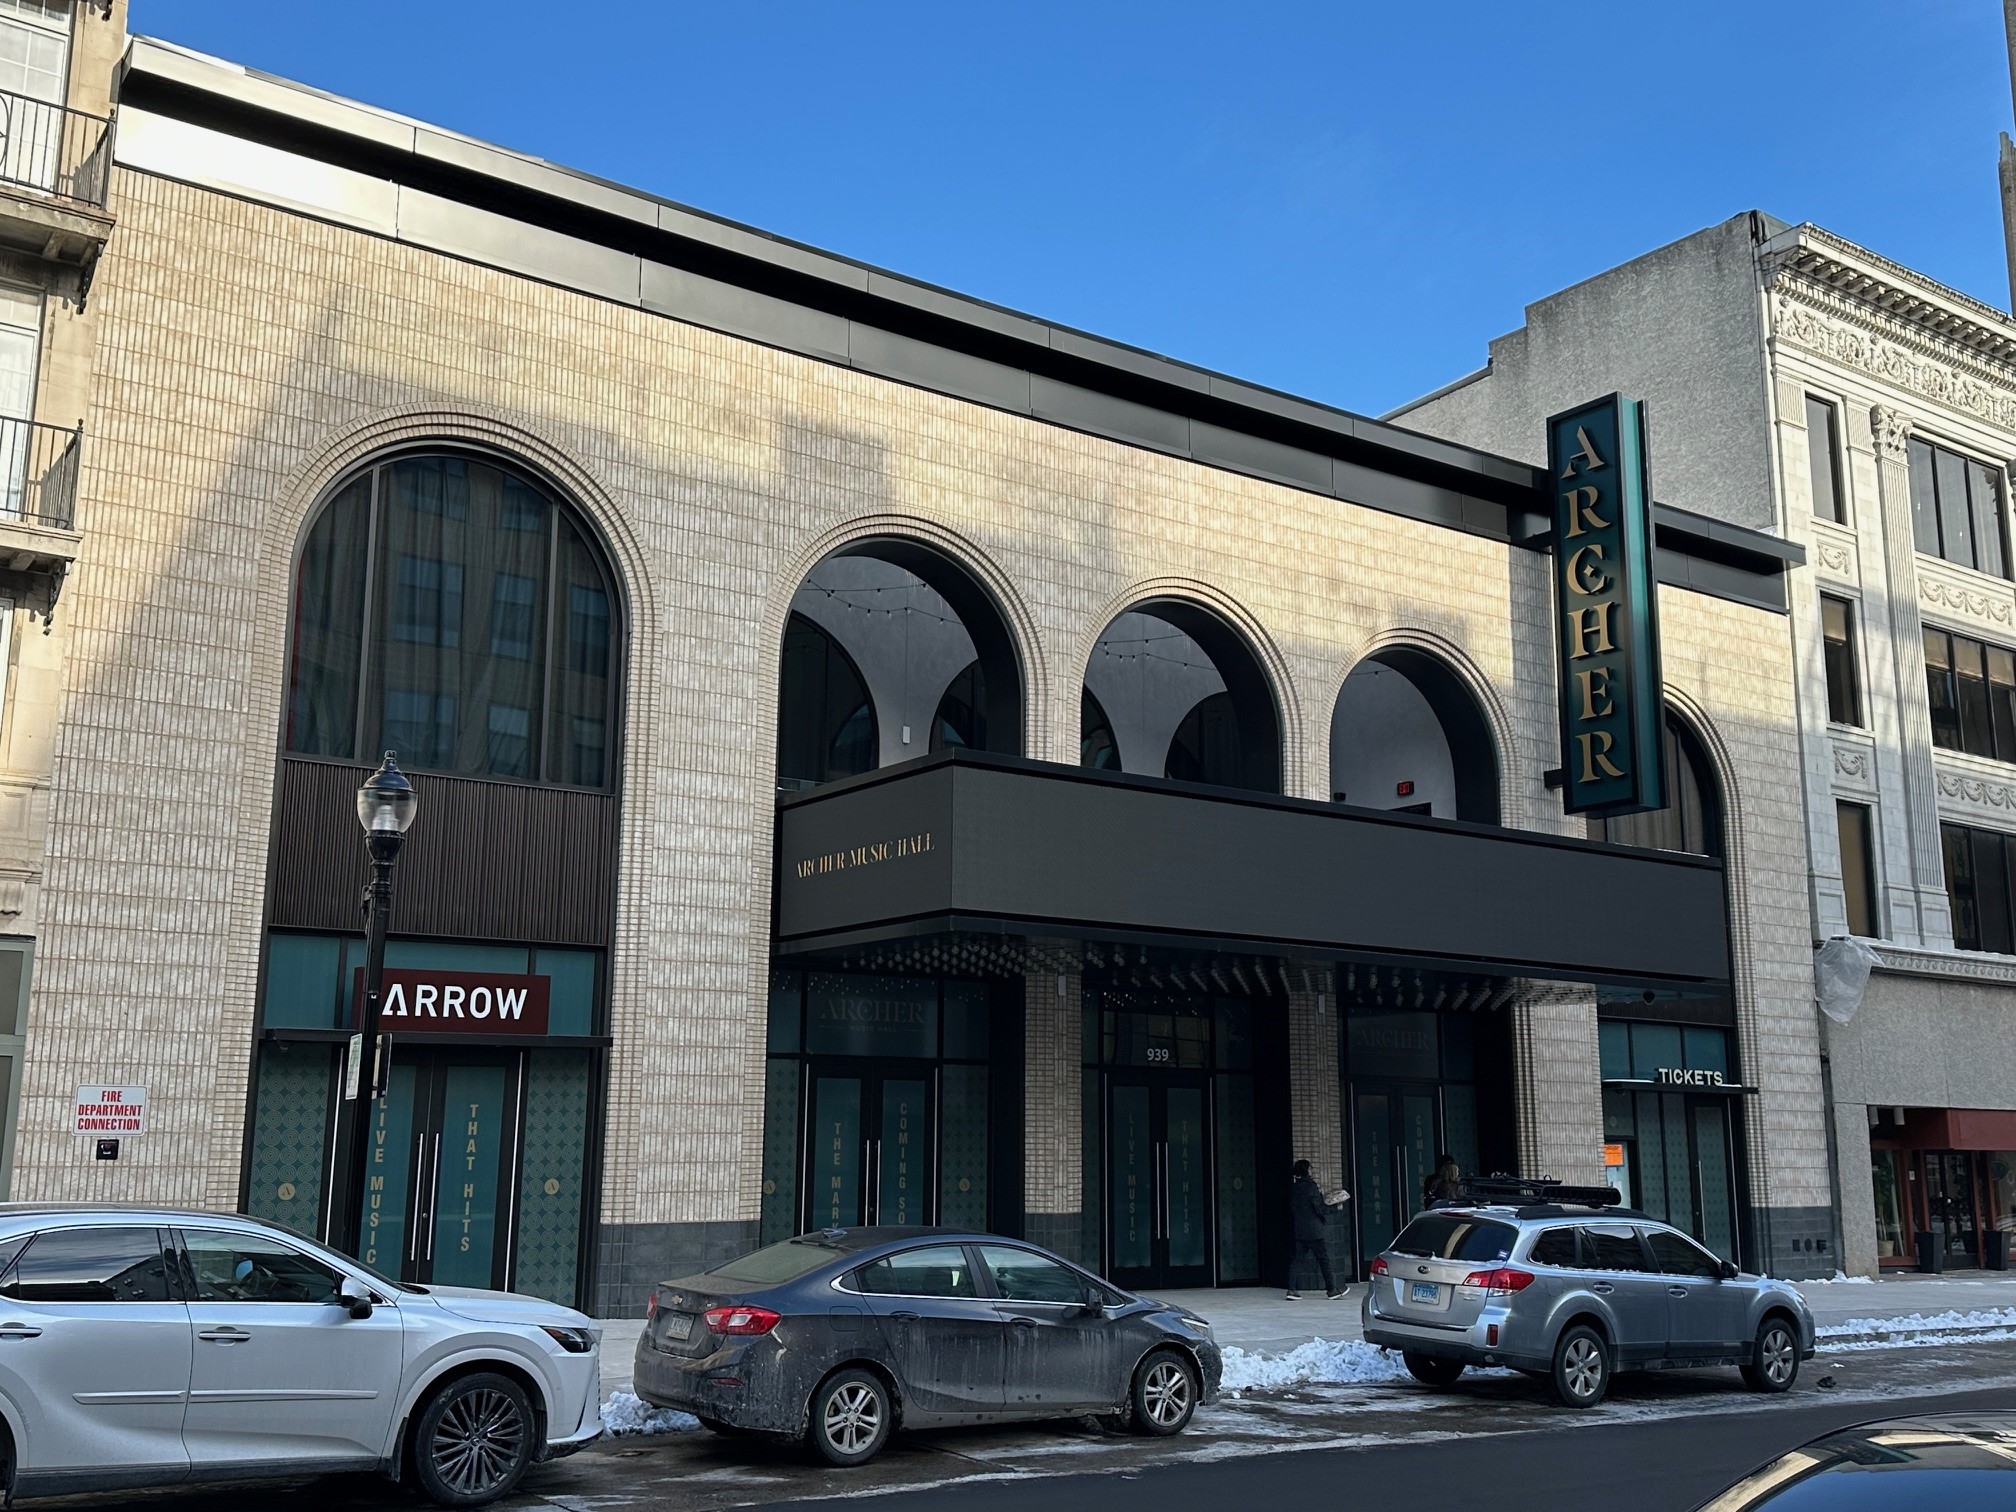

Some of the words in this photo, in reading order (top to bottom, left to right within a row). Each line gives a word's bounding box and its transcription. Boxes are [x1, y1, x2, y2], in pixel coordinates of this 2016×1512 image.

[1560, 425, 1625, 783] ARCHER
[796, 851, 846, 879] ARCHER
[849, 840, 894, 868] MUSIC
[897, 832, 936, 857] HALL
[381, 983, 528, 1020] ARROW
[819, 997, 926, 1025] ARCHER
[1146, 1048, 1170, 1062] 939
[1658, 1068, 1723, 1086] TICKETS
[78, 1104, 143, 1116] DEPARTMENT
[101, 1091, 122, 1102] FIRE
[77, 1118, 140, 1130] CONNECTION
[375, 1097, 388, 1163] LIVE
[466, 1104, 479, 1171] THAT
[833, 1122, 842, 1166] THE
[898, 1103, 908, 1188] COMING
[366, 1176, 384, 1264] MUSIC
[460, 1183, 474, 1252] HITS
[1127, 1174, 1136, 1243] MUSIC
